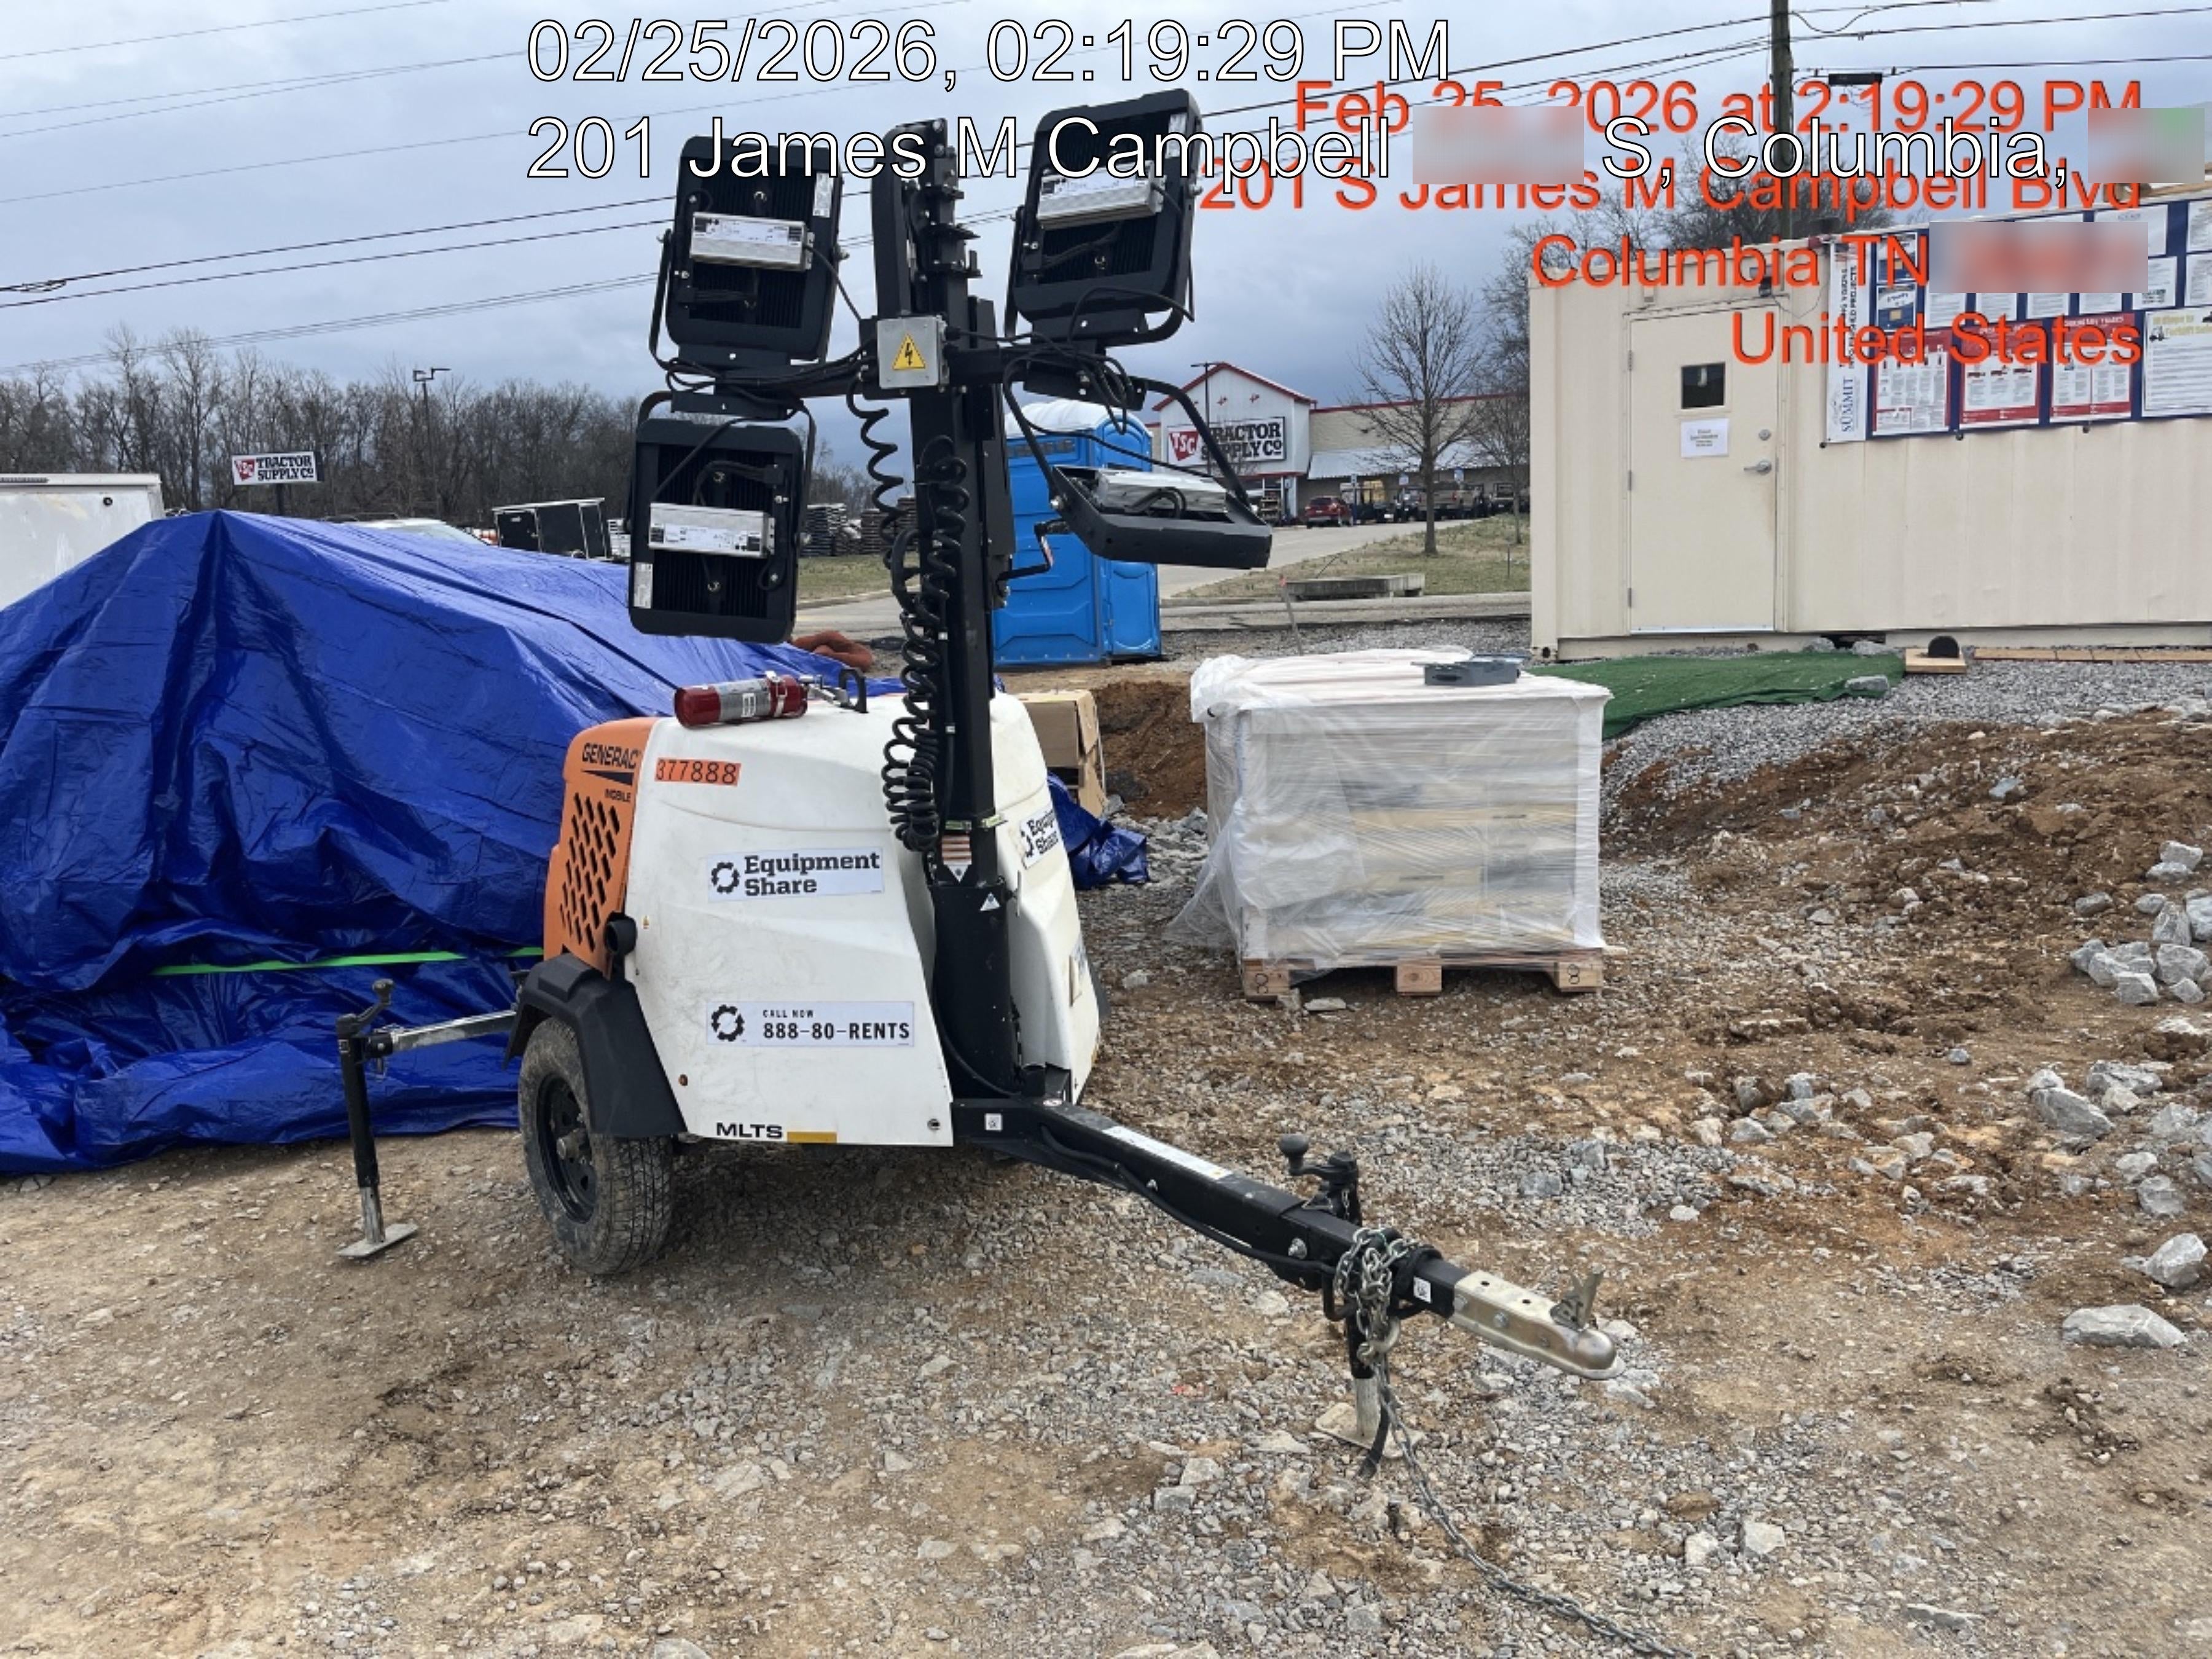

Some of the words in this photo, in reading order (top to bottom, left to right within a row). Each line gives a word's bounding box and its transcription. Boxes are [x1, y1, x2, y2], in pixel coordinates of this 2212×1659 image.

[1840, 376, 1853, 433] SUMMIT
[1206, 422, 1282, 442] RACTOR
[1171, 432, 1196, 455] TSC
[1201, 441, 1261, 460] SPPLY
[256, 455, 312, 469] TRACTOR
[257, 468, 299, 481] SUPPLY
[582, 742, 638, 769] GENERAC
[657, 759, 737, 784] 377888
[605, 788, 631, 802] MOBILE
[744, 852, 880, 877] Equipment
[744, 877, 817, 896] Share
[763, 1010, 788, 1019] CALL
[792, 1010, 814, 1019] NOW
[763, 1022, 910, 1040] 888-80-RENTS
[716, 1123, 783, 1139] MLTS
